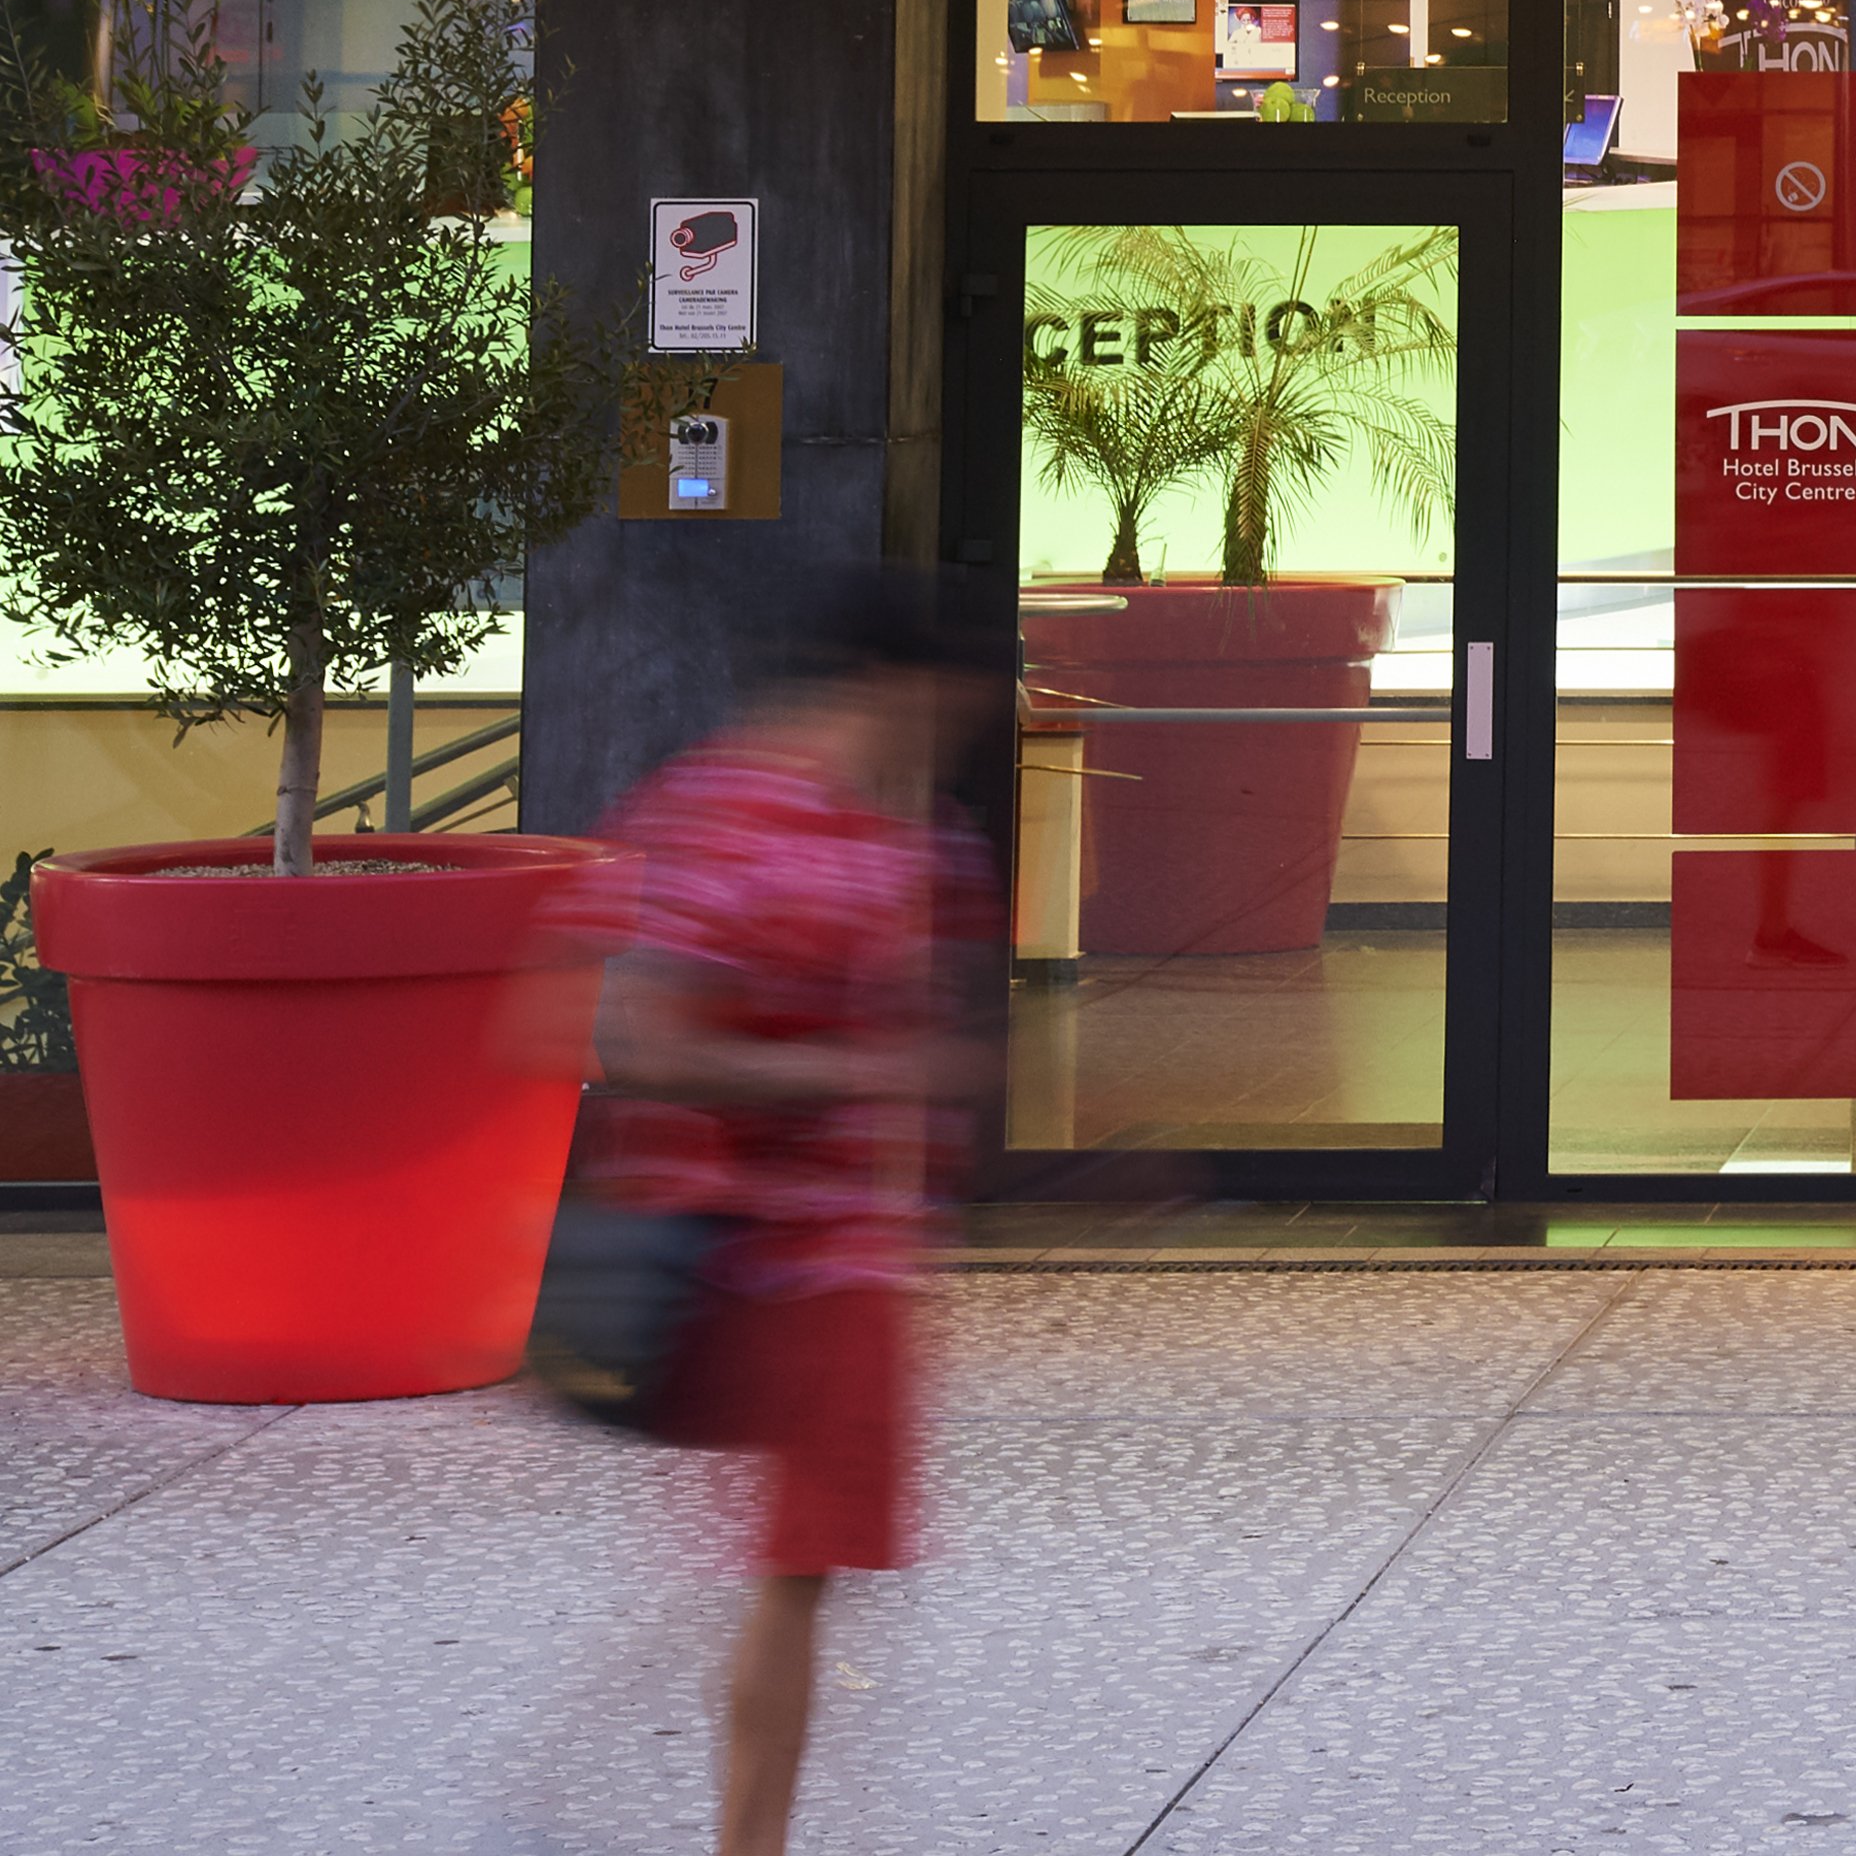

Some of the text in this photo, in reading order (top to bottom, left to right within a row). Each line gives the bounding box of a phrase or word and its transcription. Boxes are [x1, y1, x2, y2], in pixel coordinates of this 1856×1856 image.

[1364, 88, 1451, 107] Reception
[1723, 458, 1779, 477] Hotel
[1735, 481, 1856, 505] City Centre
